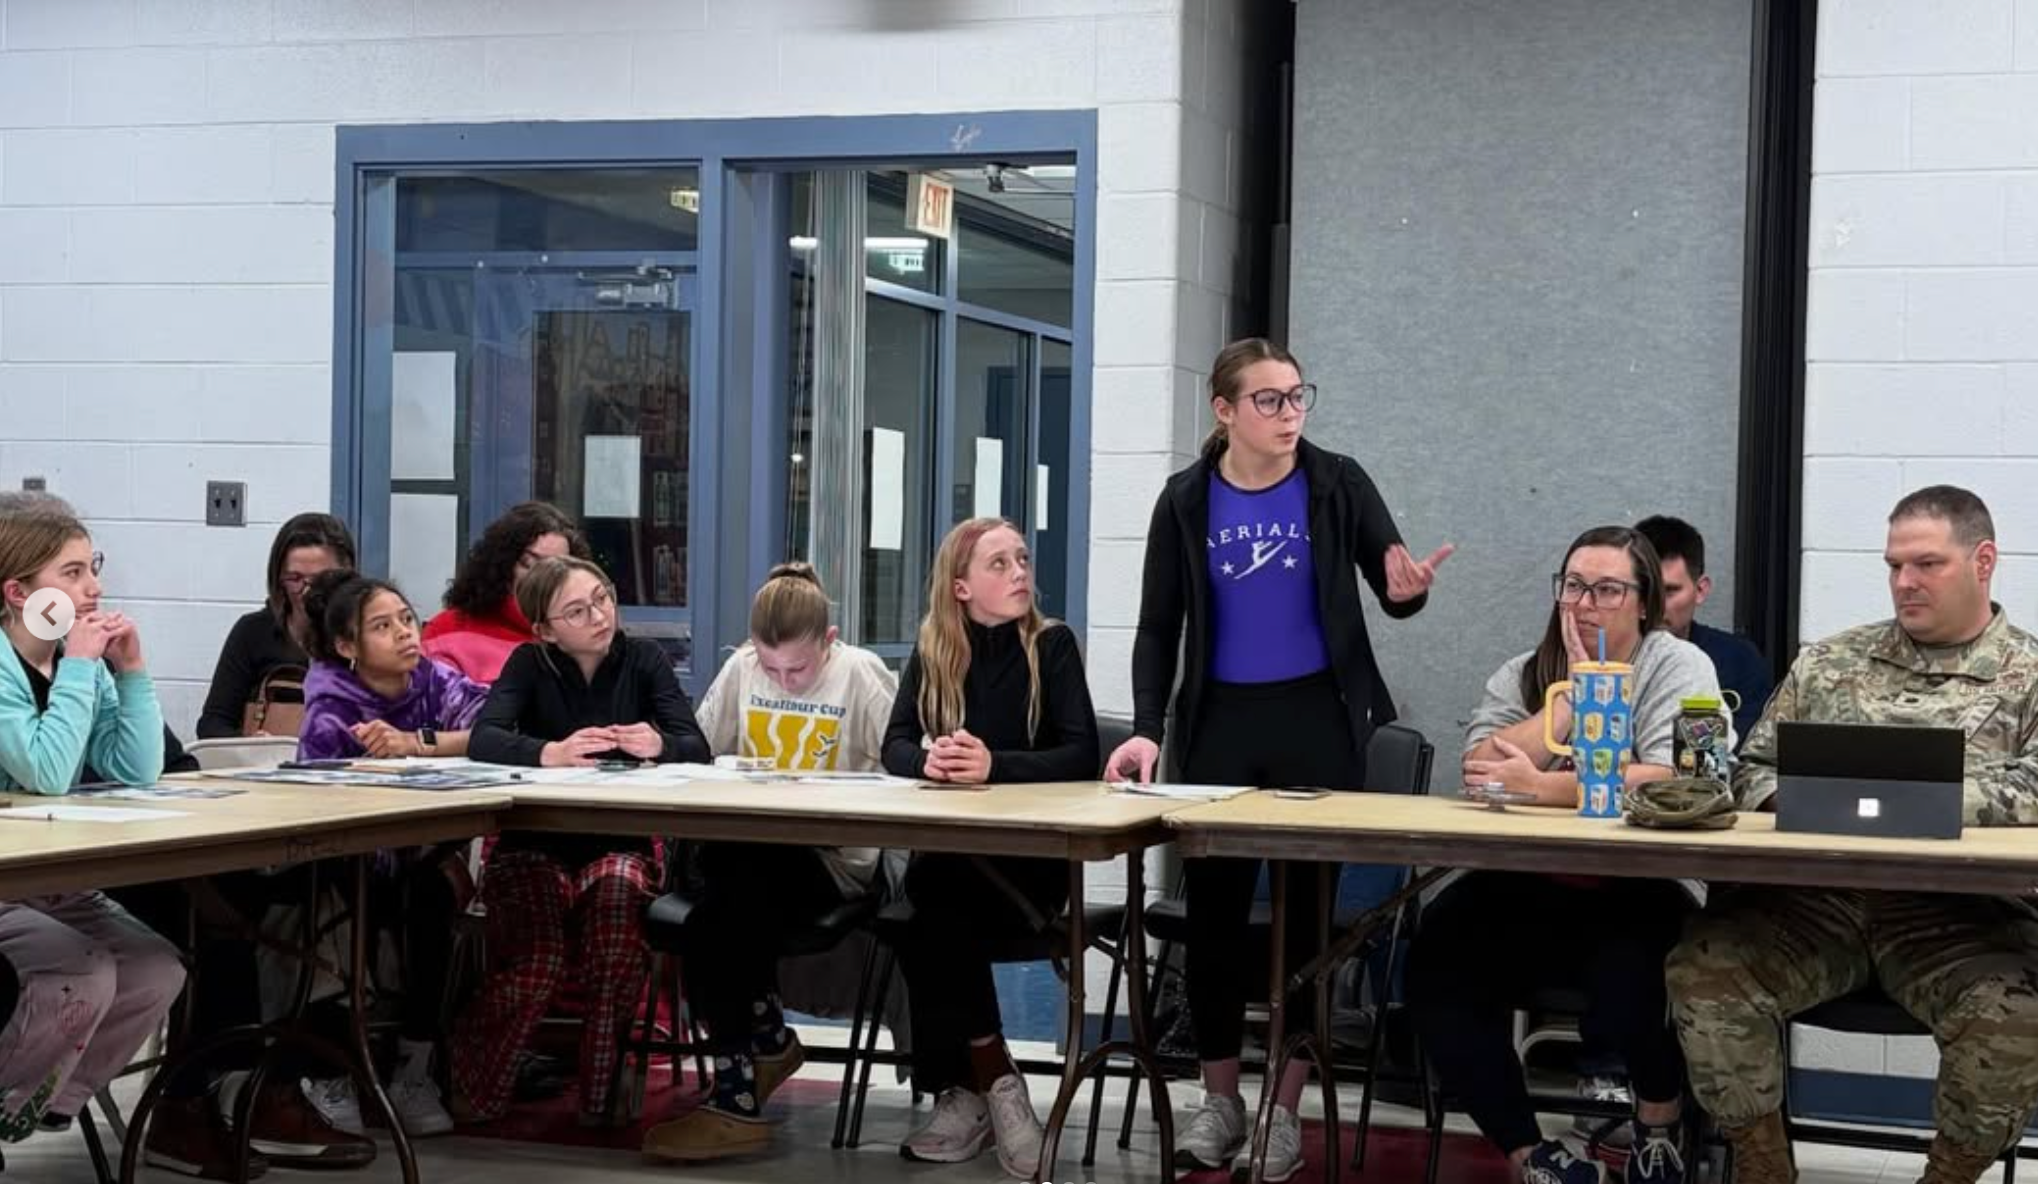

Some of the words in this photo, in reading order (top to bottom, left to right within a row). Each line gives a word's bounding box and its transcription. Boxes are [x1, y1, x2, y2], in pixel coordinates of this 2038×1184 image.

[924, 183, 949, 229] EXIT
[1206, 523, 1311, 548] AERIAL
[820, 703, 846, 719] Cup
